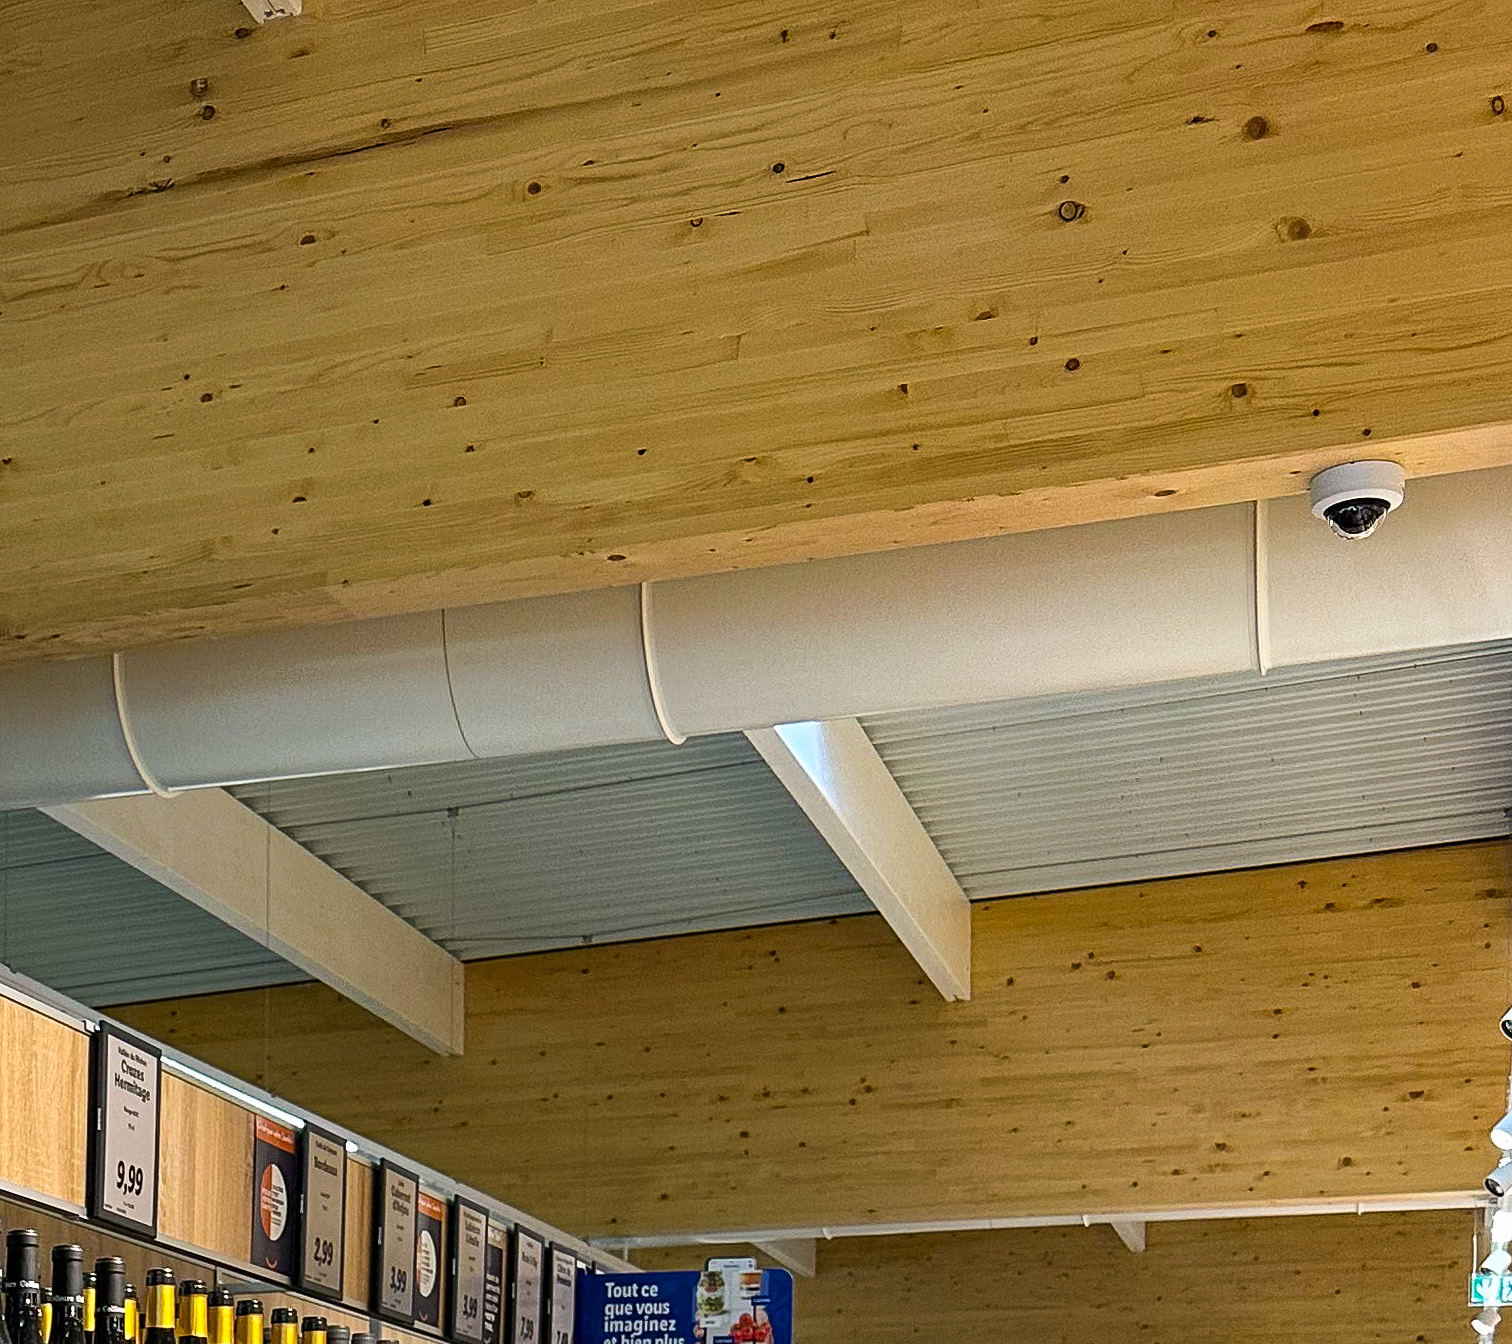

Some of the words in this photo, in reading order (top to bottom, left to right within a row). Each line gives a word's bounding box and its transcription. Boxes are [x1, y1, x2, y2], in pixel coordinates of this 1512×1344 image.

[117, 1161, 143, 1196] 9,99
[605, 1282, 638, 1298] Tout
[641, 1285, 658, 1297] ce
[604, 1304, 633, 1319] que
[636, 1302, 670, 1315] vous
[604, 1316, 676, 1336] imaginez
